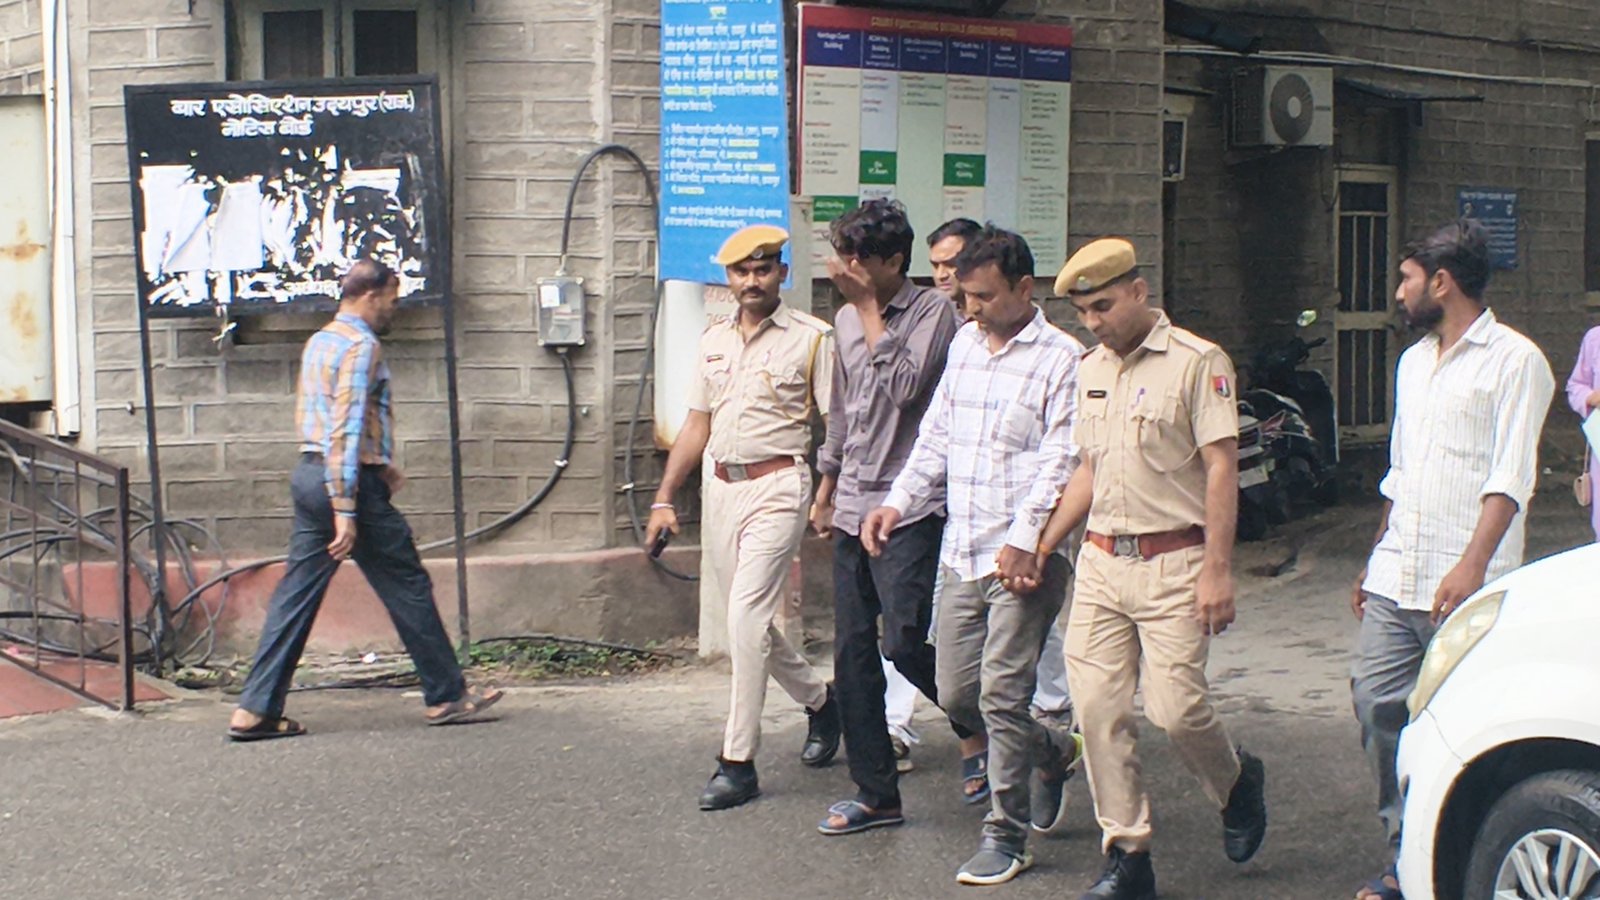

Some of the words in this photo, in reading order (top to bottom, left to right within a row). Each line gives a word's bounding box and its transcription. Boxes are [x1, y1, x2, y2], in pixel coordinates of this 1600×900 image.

[311, 95, 379, 117] उदयपुर
[220, 117, 277, 138] नोटिस
[278, 113, 314, 136] बोर्ड
